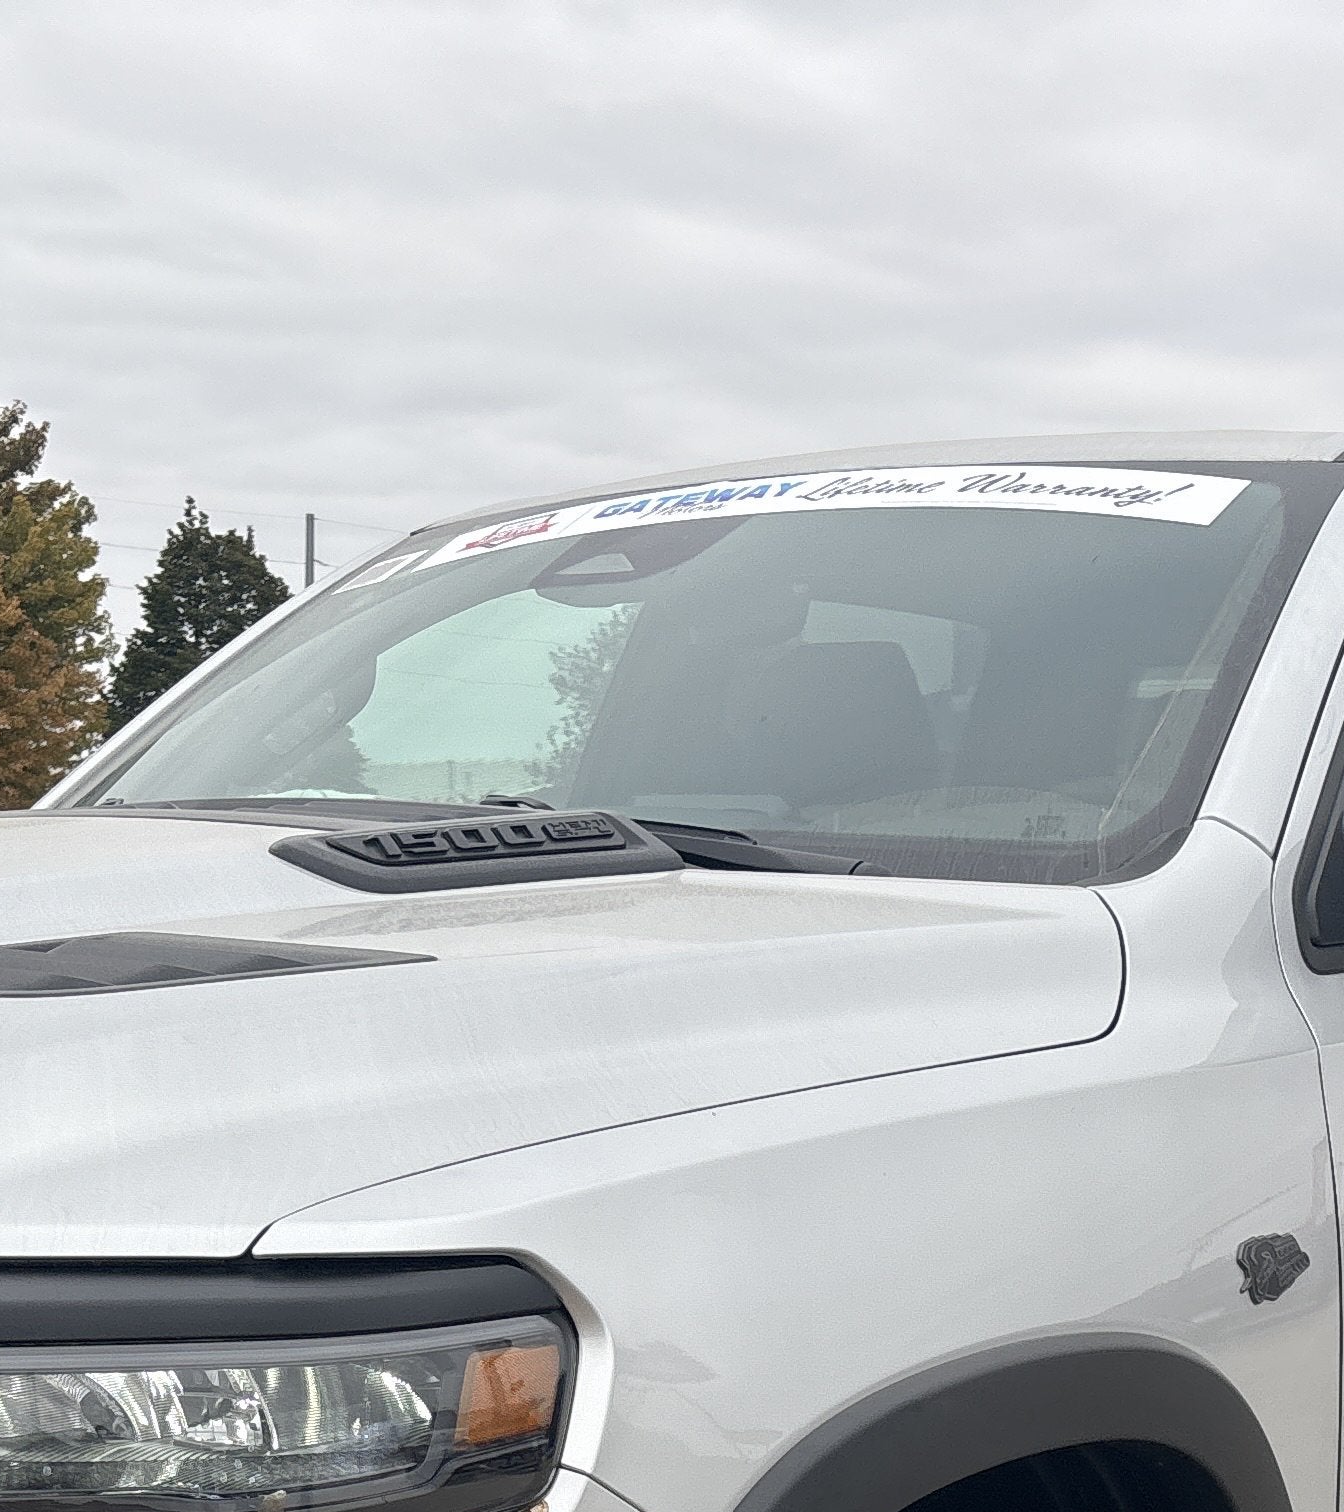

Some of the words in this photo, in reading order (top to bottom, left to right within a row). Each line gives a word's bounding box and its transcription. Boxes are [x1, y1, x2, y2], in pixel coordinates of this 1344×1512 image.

[593, 481, 807, 519] GATEWAY
[796, 476, 946, 502] Lifetime
[957, 472, 1195, 508] Warranty!
[362, 821, 546, 858] 1500
